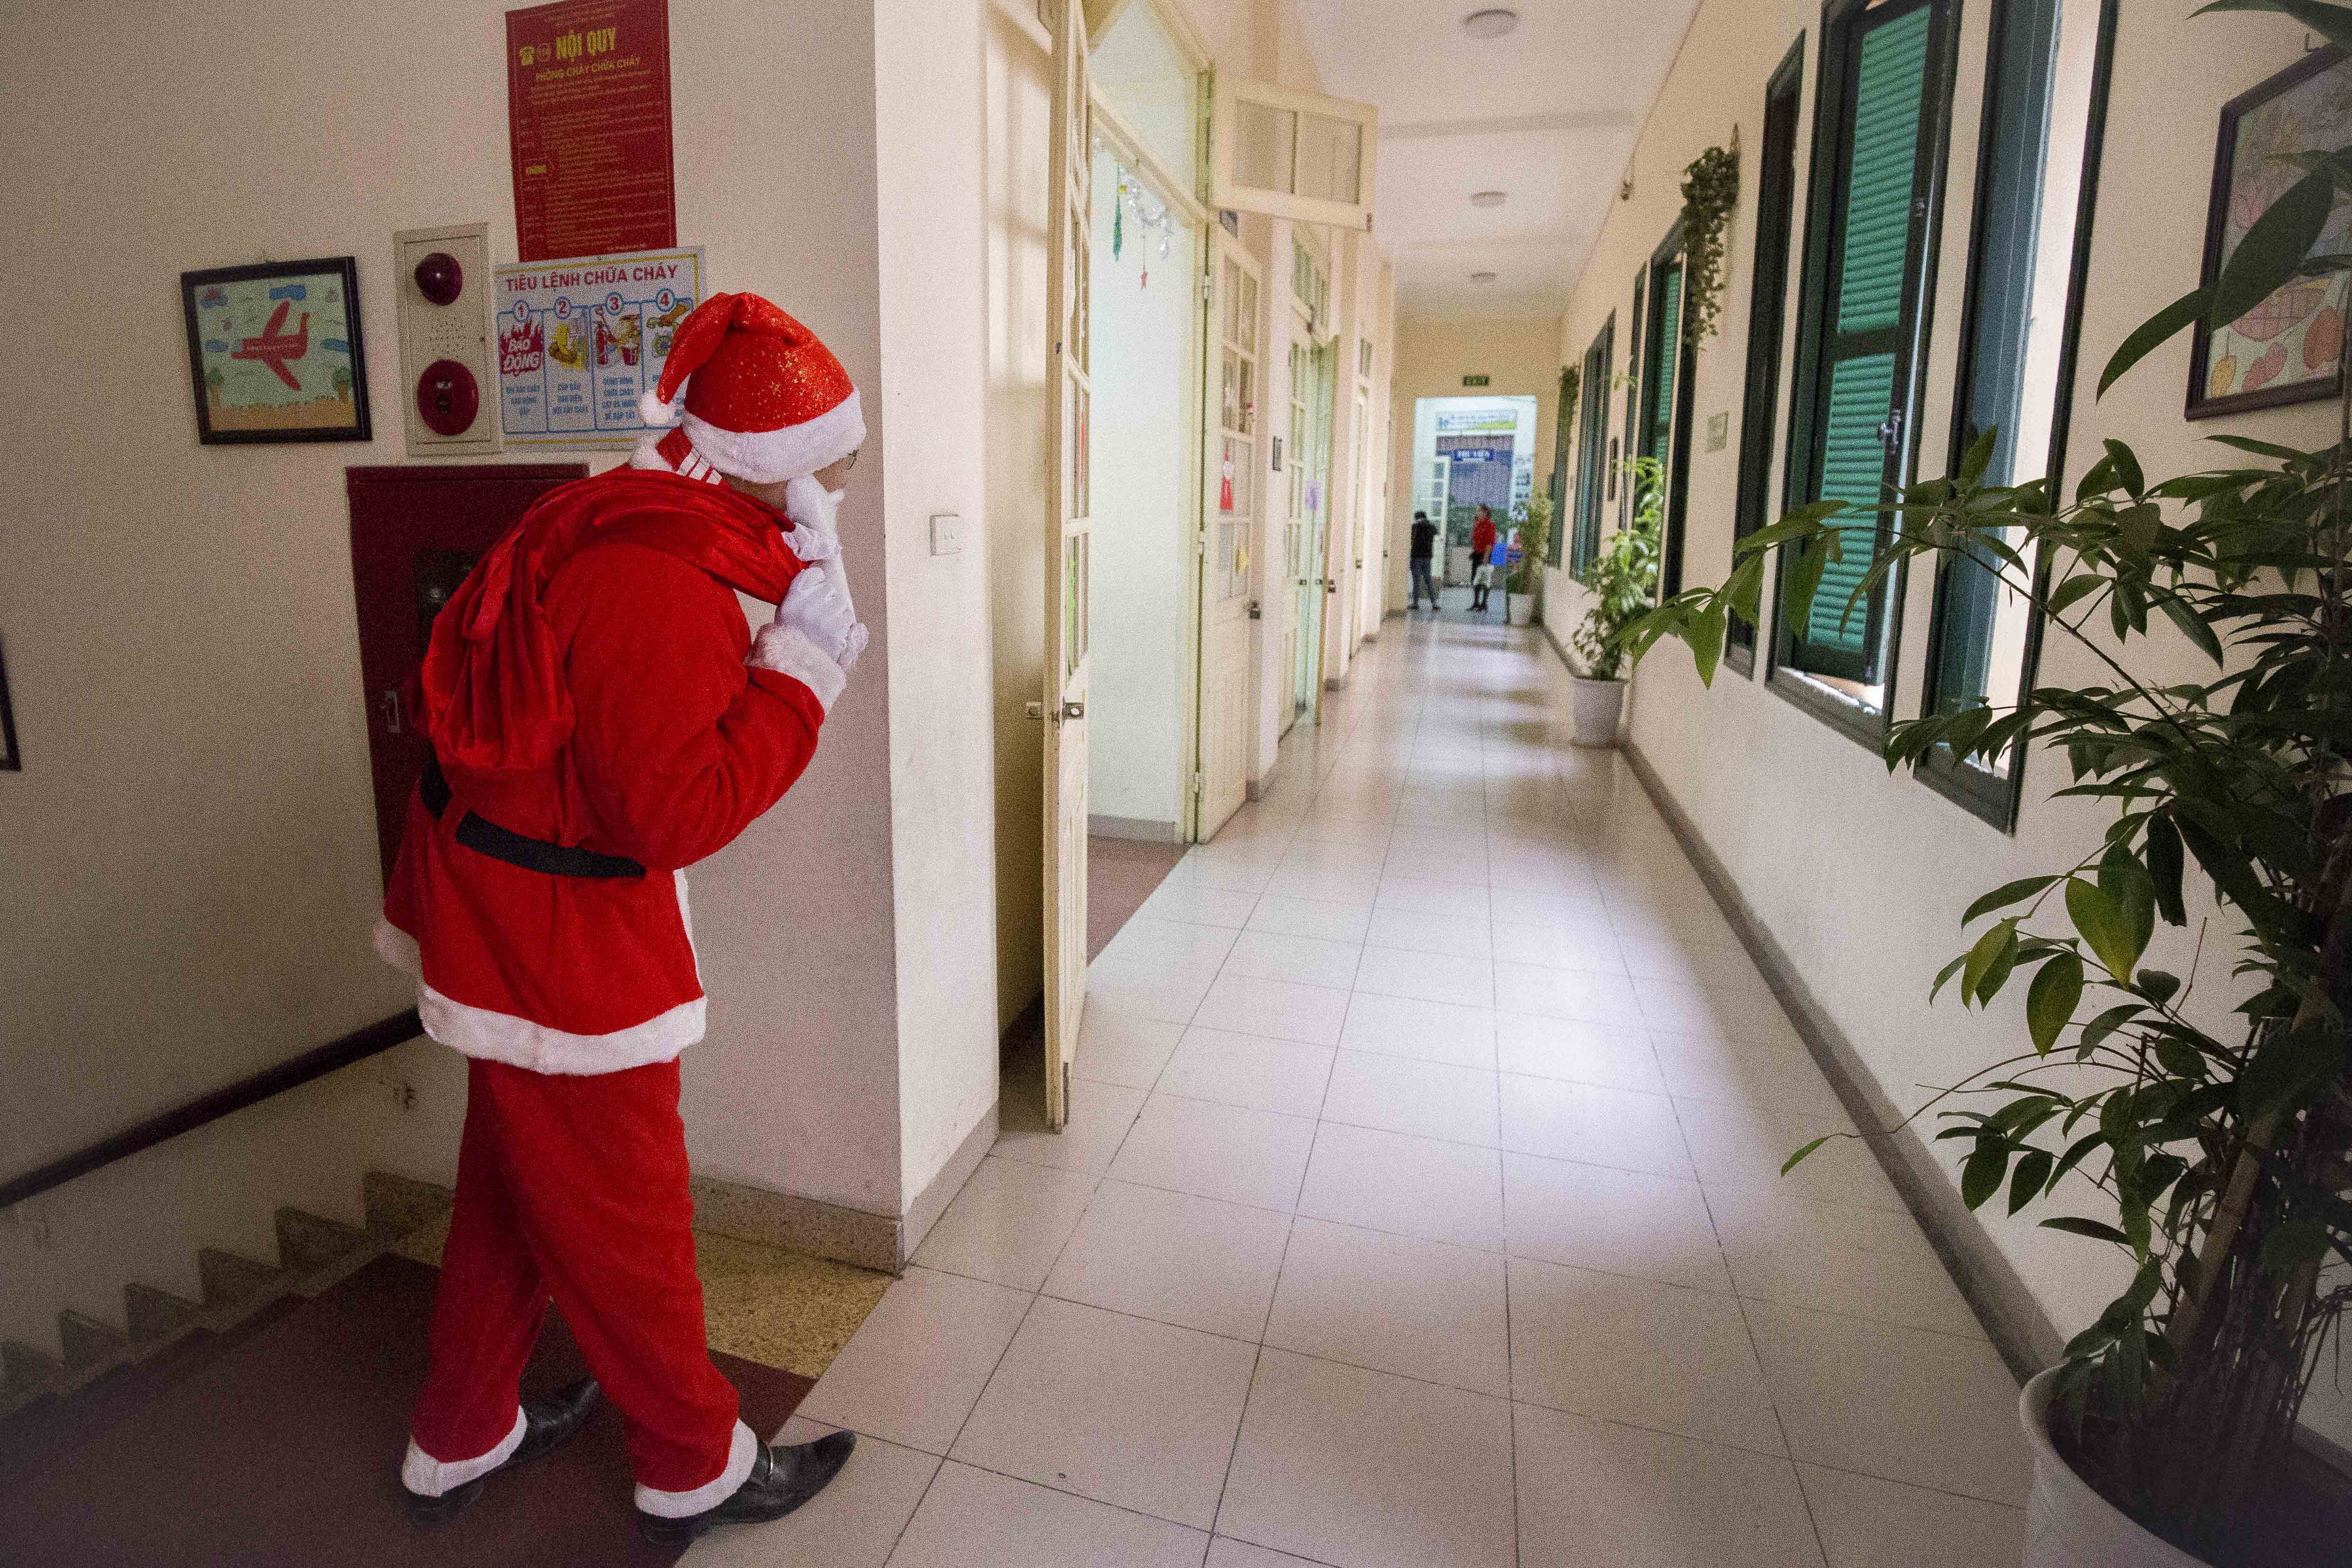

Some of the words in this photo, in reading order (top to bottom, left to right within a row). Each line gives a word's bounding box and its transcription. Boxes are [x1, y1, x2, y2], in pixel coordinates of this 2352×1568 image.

[556, 29, 583, 63] NỘI
[587, 27, 616, 56] QUY
[535, 68, 565, 82] PHÒNG
[566, 63, 590, 77] CHÁY
[591, 58, 615, 72] CHỮA
[617, 54, 640, 69] CHÁY
[506, 274, 538, 292] TIÊU
[542, 271, 580, 292] LỆNH
[584, 266, 628, 285] CHỮA
[632, 262, 678, 282] CHÁY
[558, 301, 568, 314] 2
[609, 296, 619, 311] 3
[660, 292, 670, 307] 4
[517, 305, 524, 318] 1
[508, 335, 531, 352] BÁO
[504, 352, 541, 375] ĐỘNG
